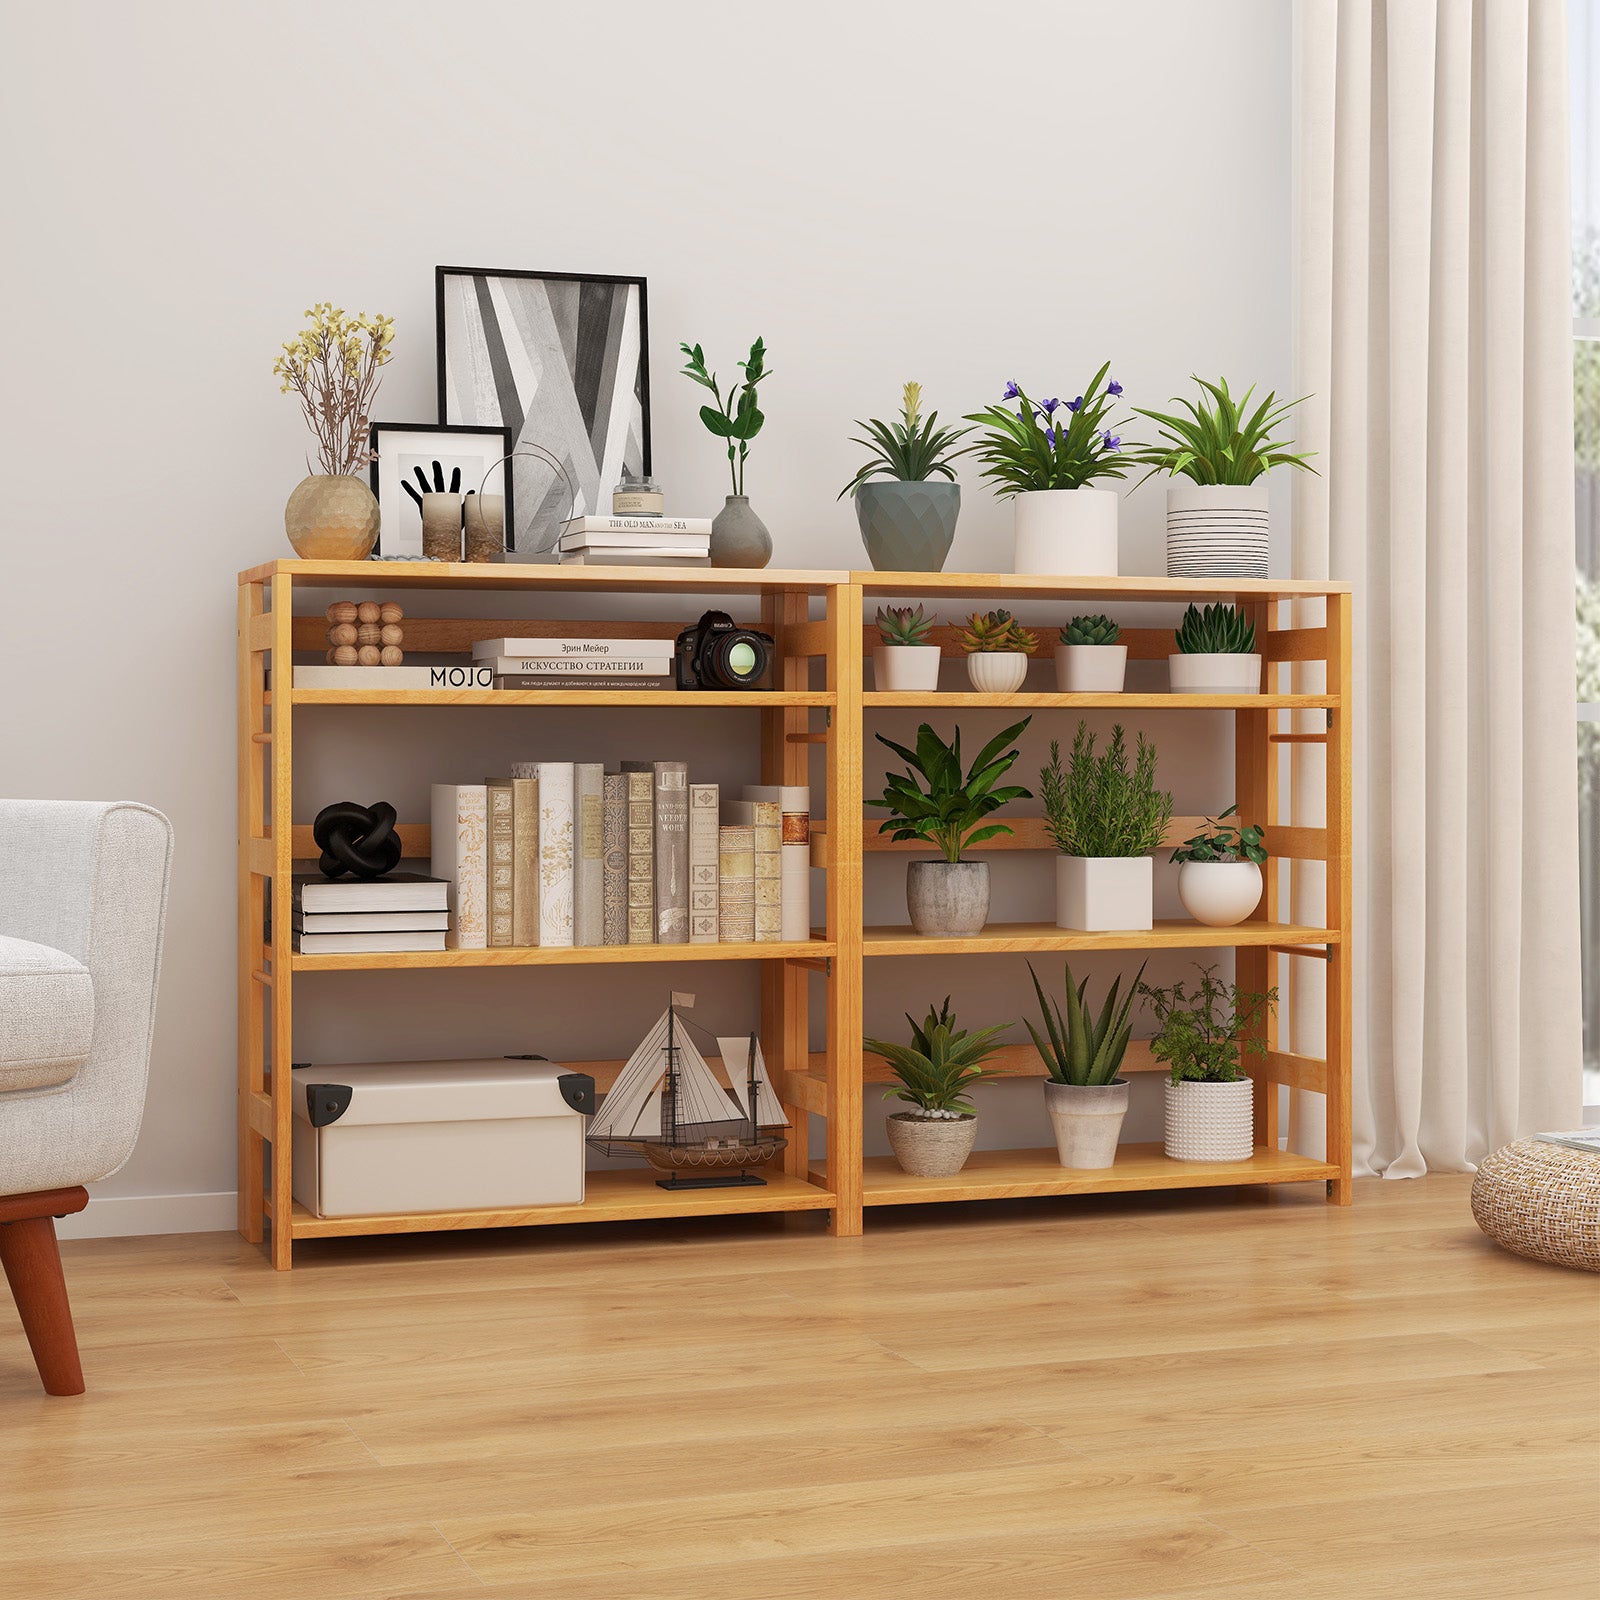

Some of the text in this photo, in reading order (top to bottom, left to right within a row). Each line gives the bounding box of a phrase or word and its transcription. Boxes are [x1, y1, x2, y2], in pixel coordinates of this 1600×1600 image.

[609, 519, 623, 528] THE
[623, 520, 639, 528] OLD
[639, 520, 655, 529] MAN
[673, 521, 687, 530] SEA
[561, 643, 609, 654] Эрин Мейер
[521, 661, 643, 671] ИСКУССТВО СТРАТЕГИИ
[430, 667, 492, 687] MOJO
